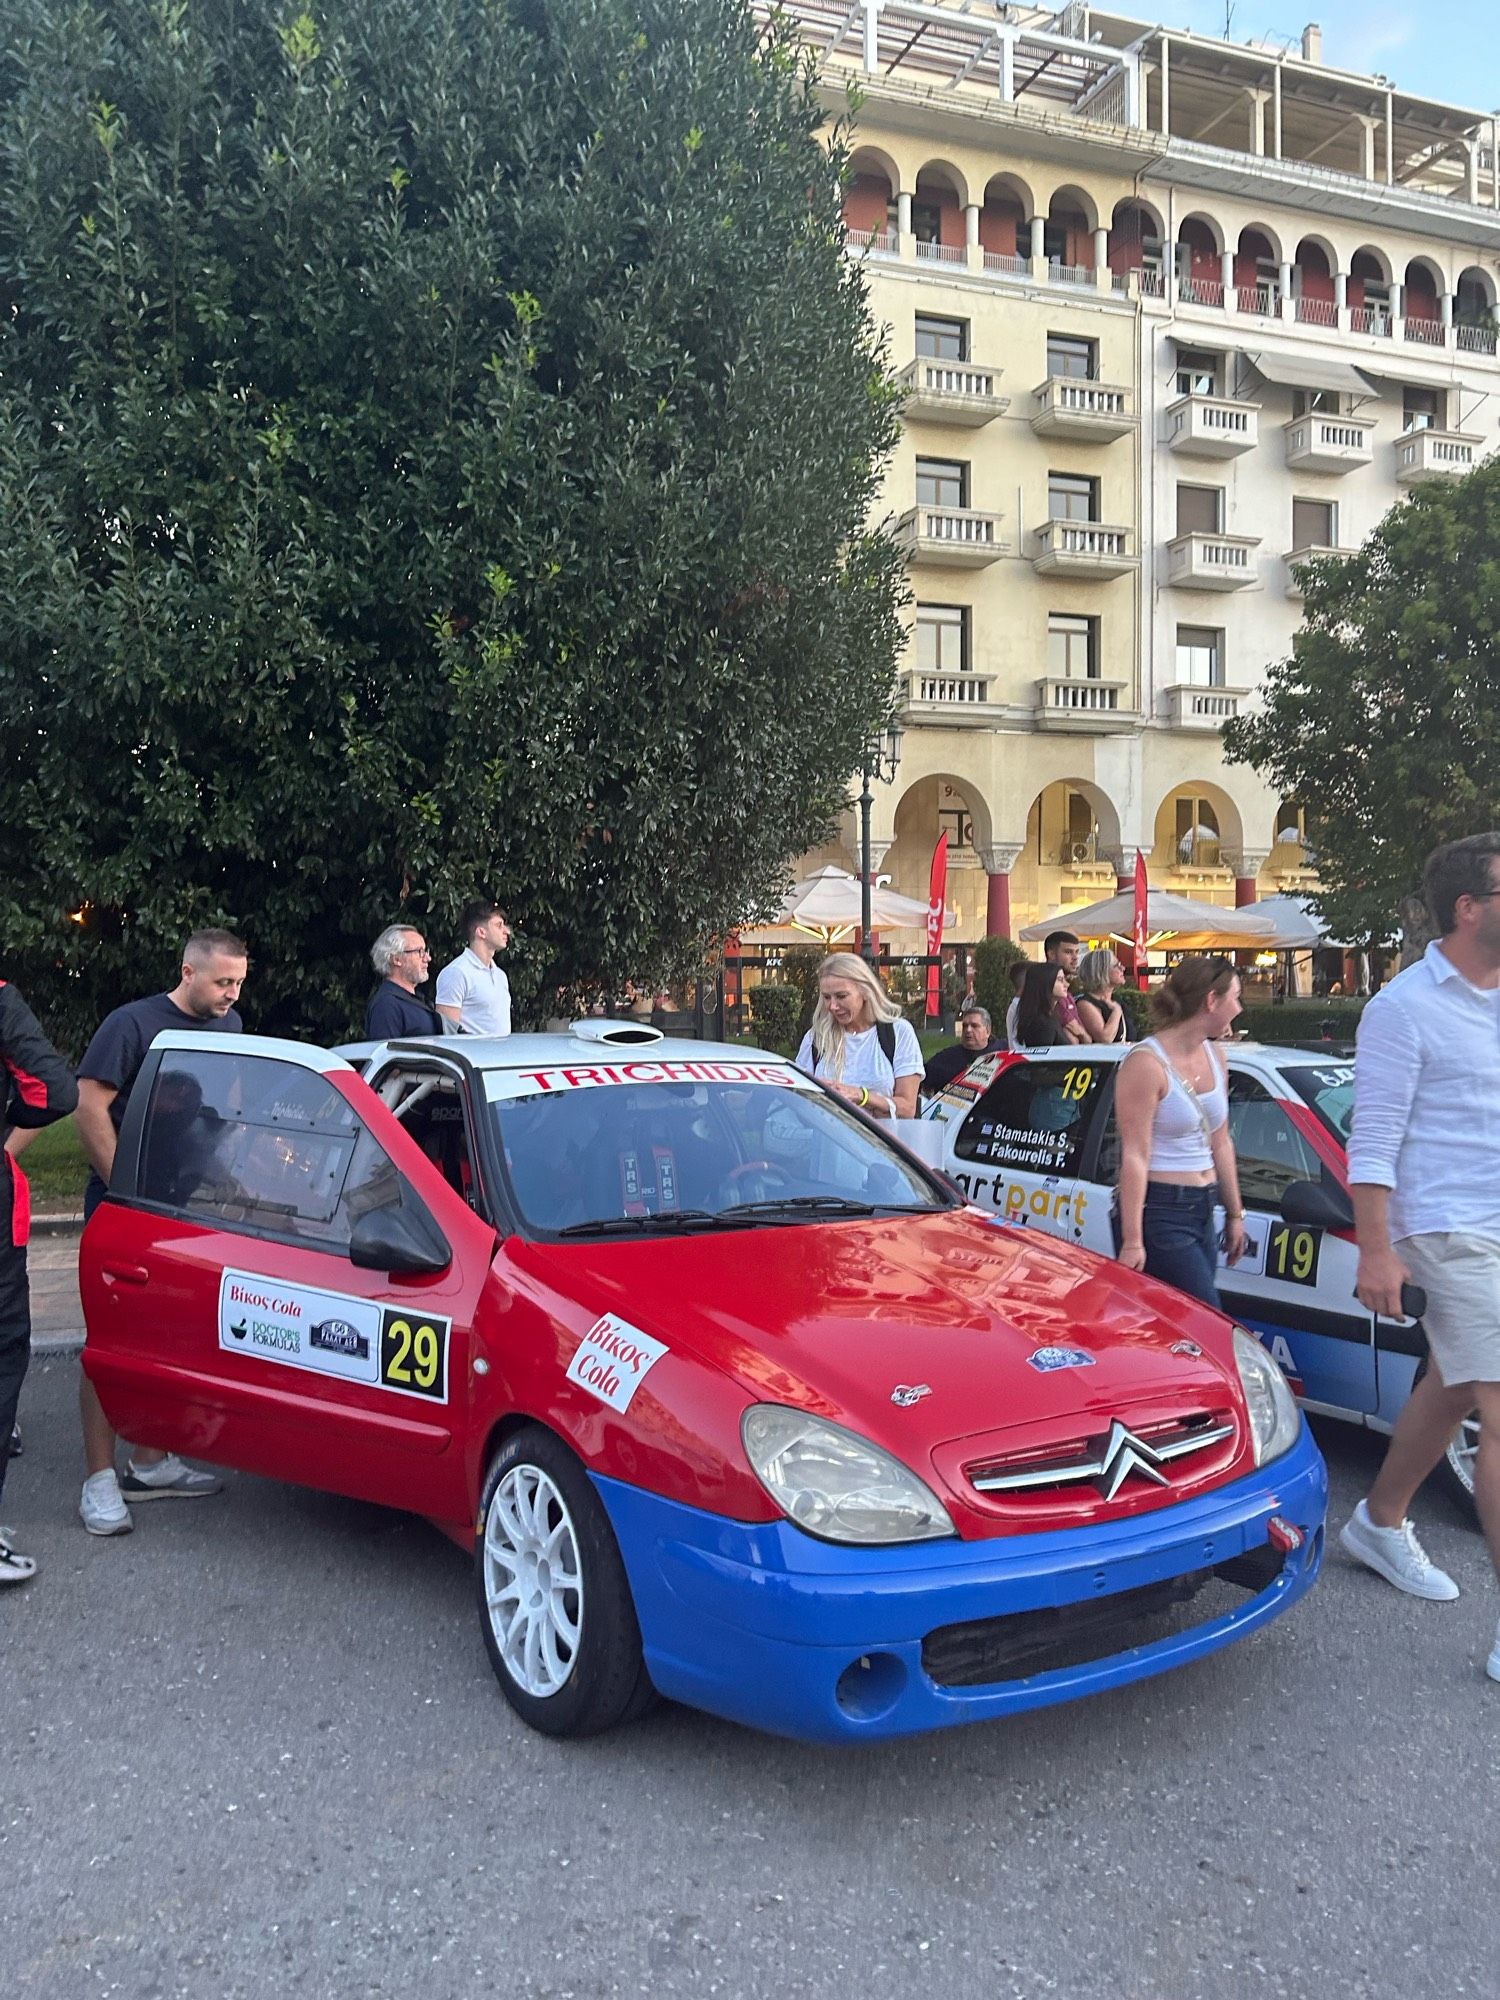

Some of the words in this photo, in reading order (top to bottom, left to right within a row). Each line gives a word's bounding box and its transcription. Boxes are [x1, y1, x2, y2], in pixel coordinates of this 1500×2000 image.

[766, 958, 783, 967] KFC
[903, 957, 919, 966] KFC
[519, 1062, 795, 1091] TRICHIDIS
[1061, 1067, 1092, 1101] 19
[993, 1123, 1056, 1147] Stamatakis
[1057, 1132, 1069, 1149] S.
[990, 1142, 1053, 1166] Fakourelis
[1055, 1151, 1066, 1168] F.
[625, 1158, 637, 1193] TRS
[661, 1165, 674, 1199] TRS
[1274, 1228, 1314, 1279] 19
[271, 1298, 301, 1318] Cola
[252, 1321, 300, 1341] DOCTOR'S
[252, 1332, 300, 1354] FORMULAS
[386, 1320, 438, 1388] 29
[577, 1353, 620, 1397] Cola
